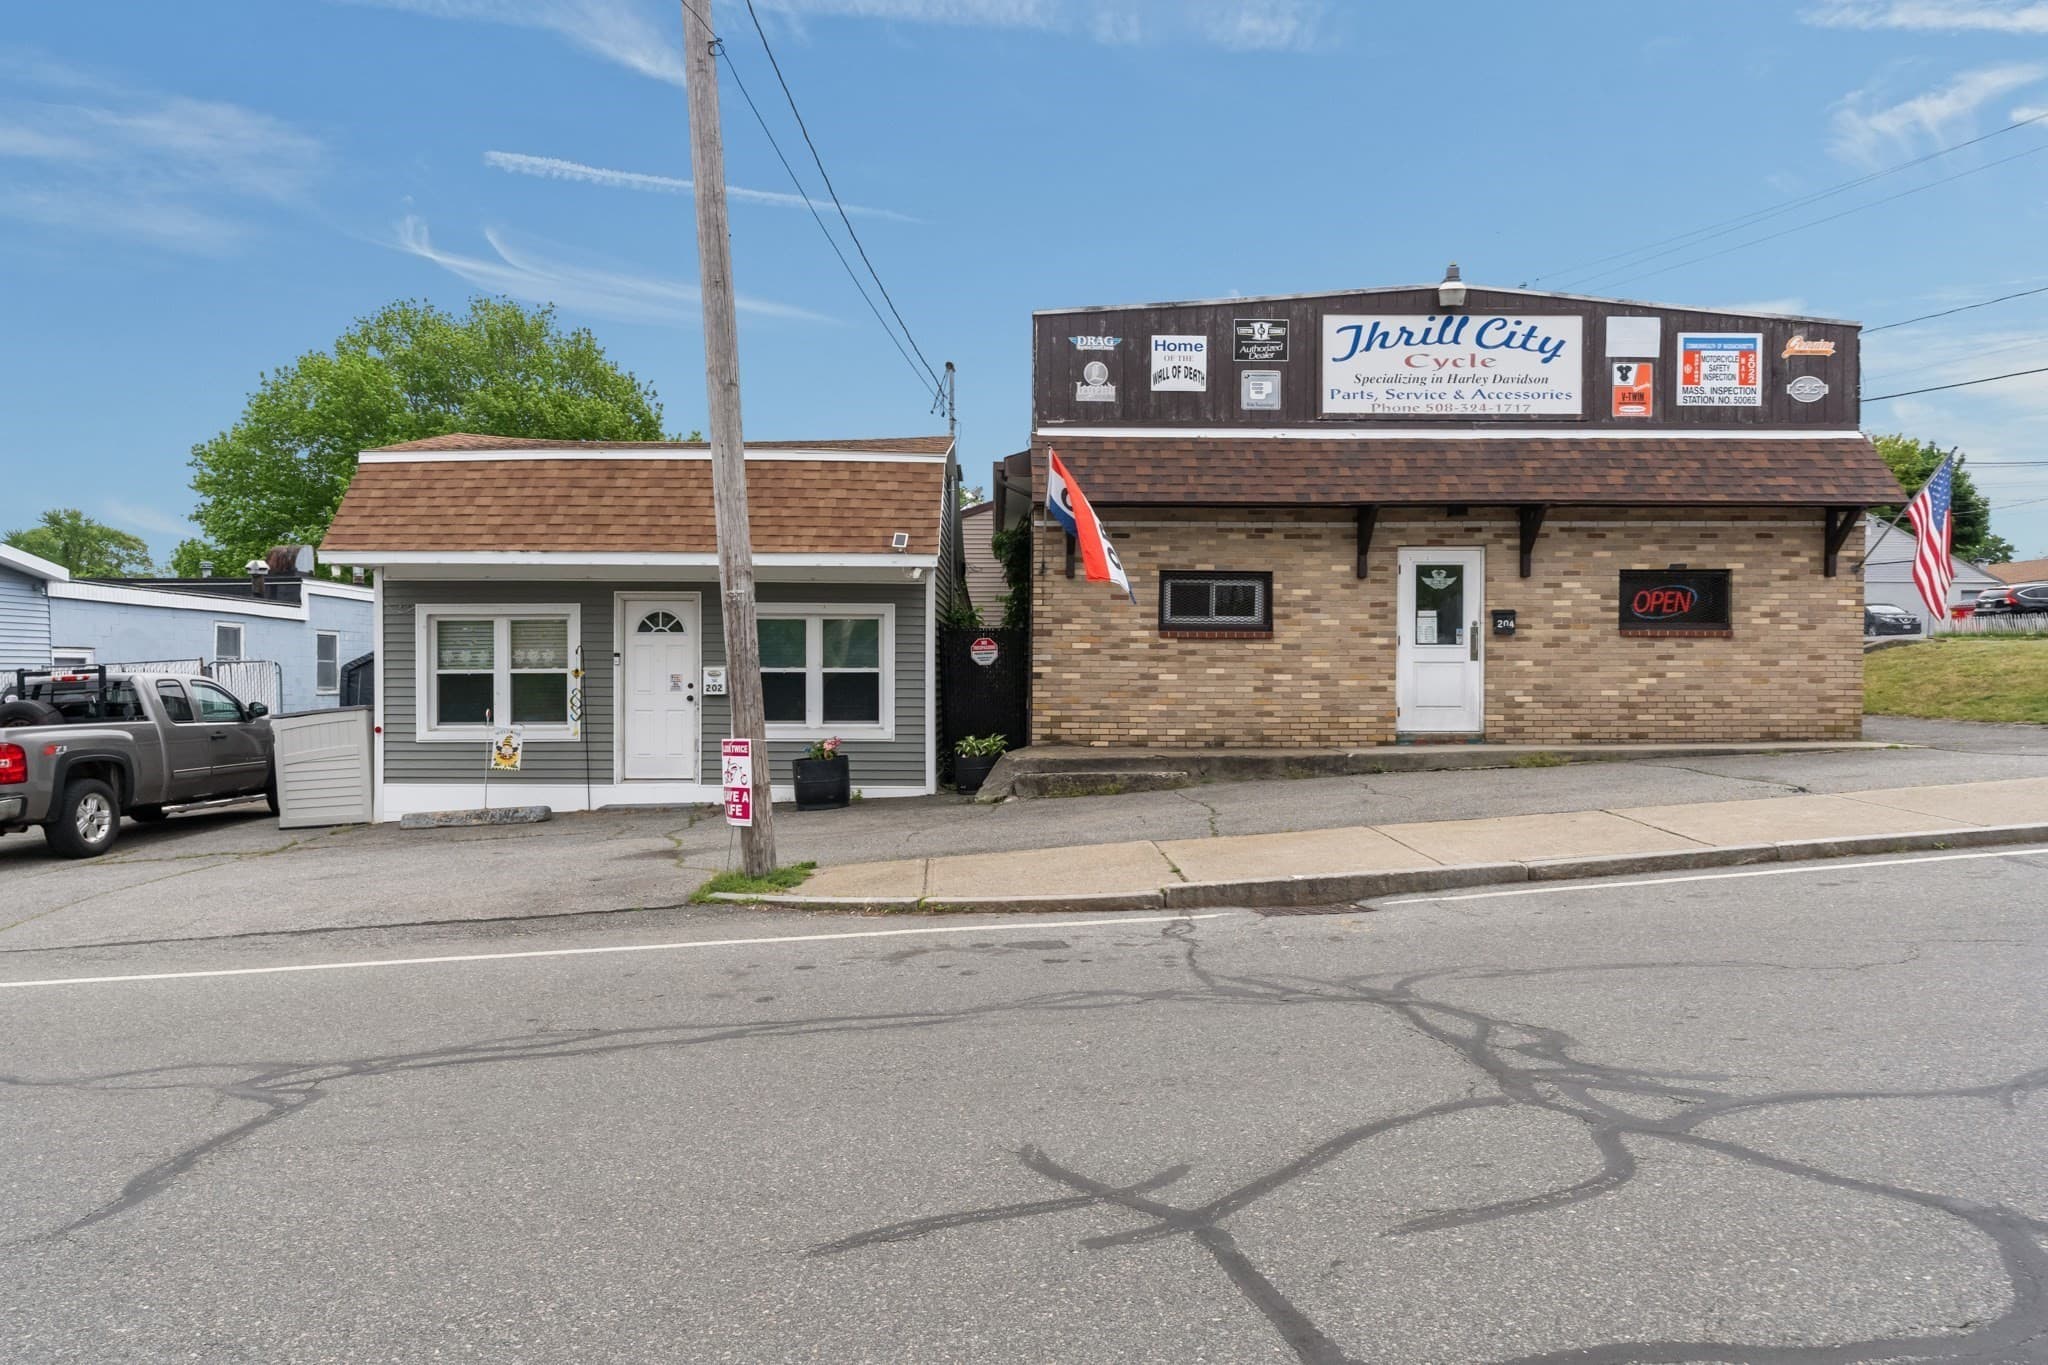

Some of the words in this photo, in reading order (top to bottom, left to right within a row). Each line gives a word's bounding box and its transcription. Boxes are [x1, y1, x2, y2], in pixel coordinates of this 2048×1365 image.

[1077, 336, 1114, 346] DRAG
[1332, 316, 1469, 362] Thrill
[1475, 318, 1566, 364] City
[1154, 340, 1204, 352] Home
[1240, 343, 1284, 353] Authorized
[1249, 352, 1275, 360] Dealer
[1701, 355, 1739, 363] MOTORCYCLE
[1404, 353, 1497, 371] Cycle
[1708, 364, 1731, 372] SAFETY
[1153, 366, 1170, 386] WALL
[1171, 365, 1182, 380] OF
[1183, 365, 1205, 386] DEATH
[1354, 373, 1428, 386] Specializing
[1431, 373, 1444, 384] in
[1447, 373, 1488, 386] Harley
[1492, 373, 1549, 385] Davidson
[1703, 373, 1737, 381] INSPECTION
[1330, 388, 1379, 402] Parts,
[1385, 388, 1447, 400] Service
[1453, 389, 1465, 400] &
[1471, 388, 1573, 401] Accessories
[1682, 386, 1706, 395] MASS.
[1710, 386, 1757, 395] INSPECTION
[1682, 395, 1714, 404] STATION
[1371, 403, 1420, 413] Phone
[1425, 403, 1531, 413] 508-324-1717
[1633, 590, 1692, 613] OPEN
[1497, 619, 1515, 629] 204
[705, 684, 723, 692] 202
[731, 744, 748, 753] TWICE
[742, 790, 750, 802] A
